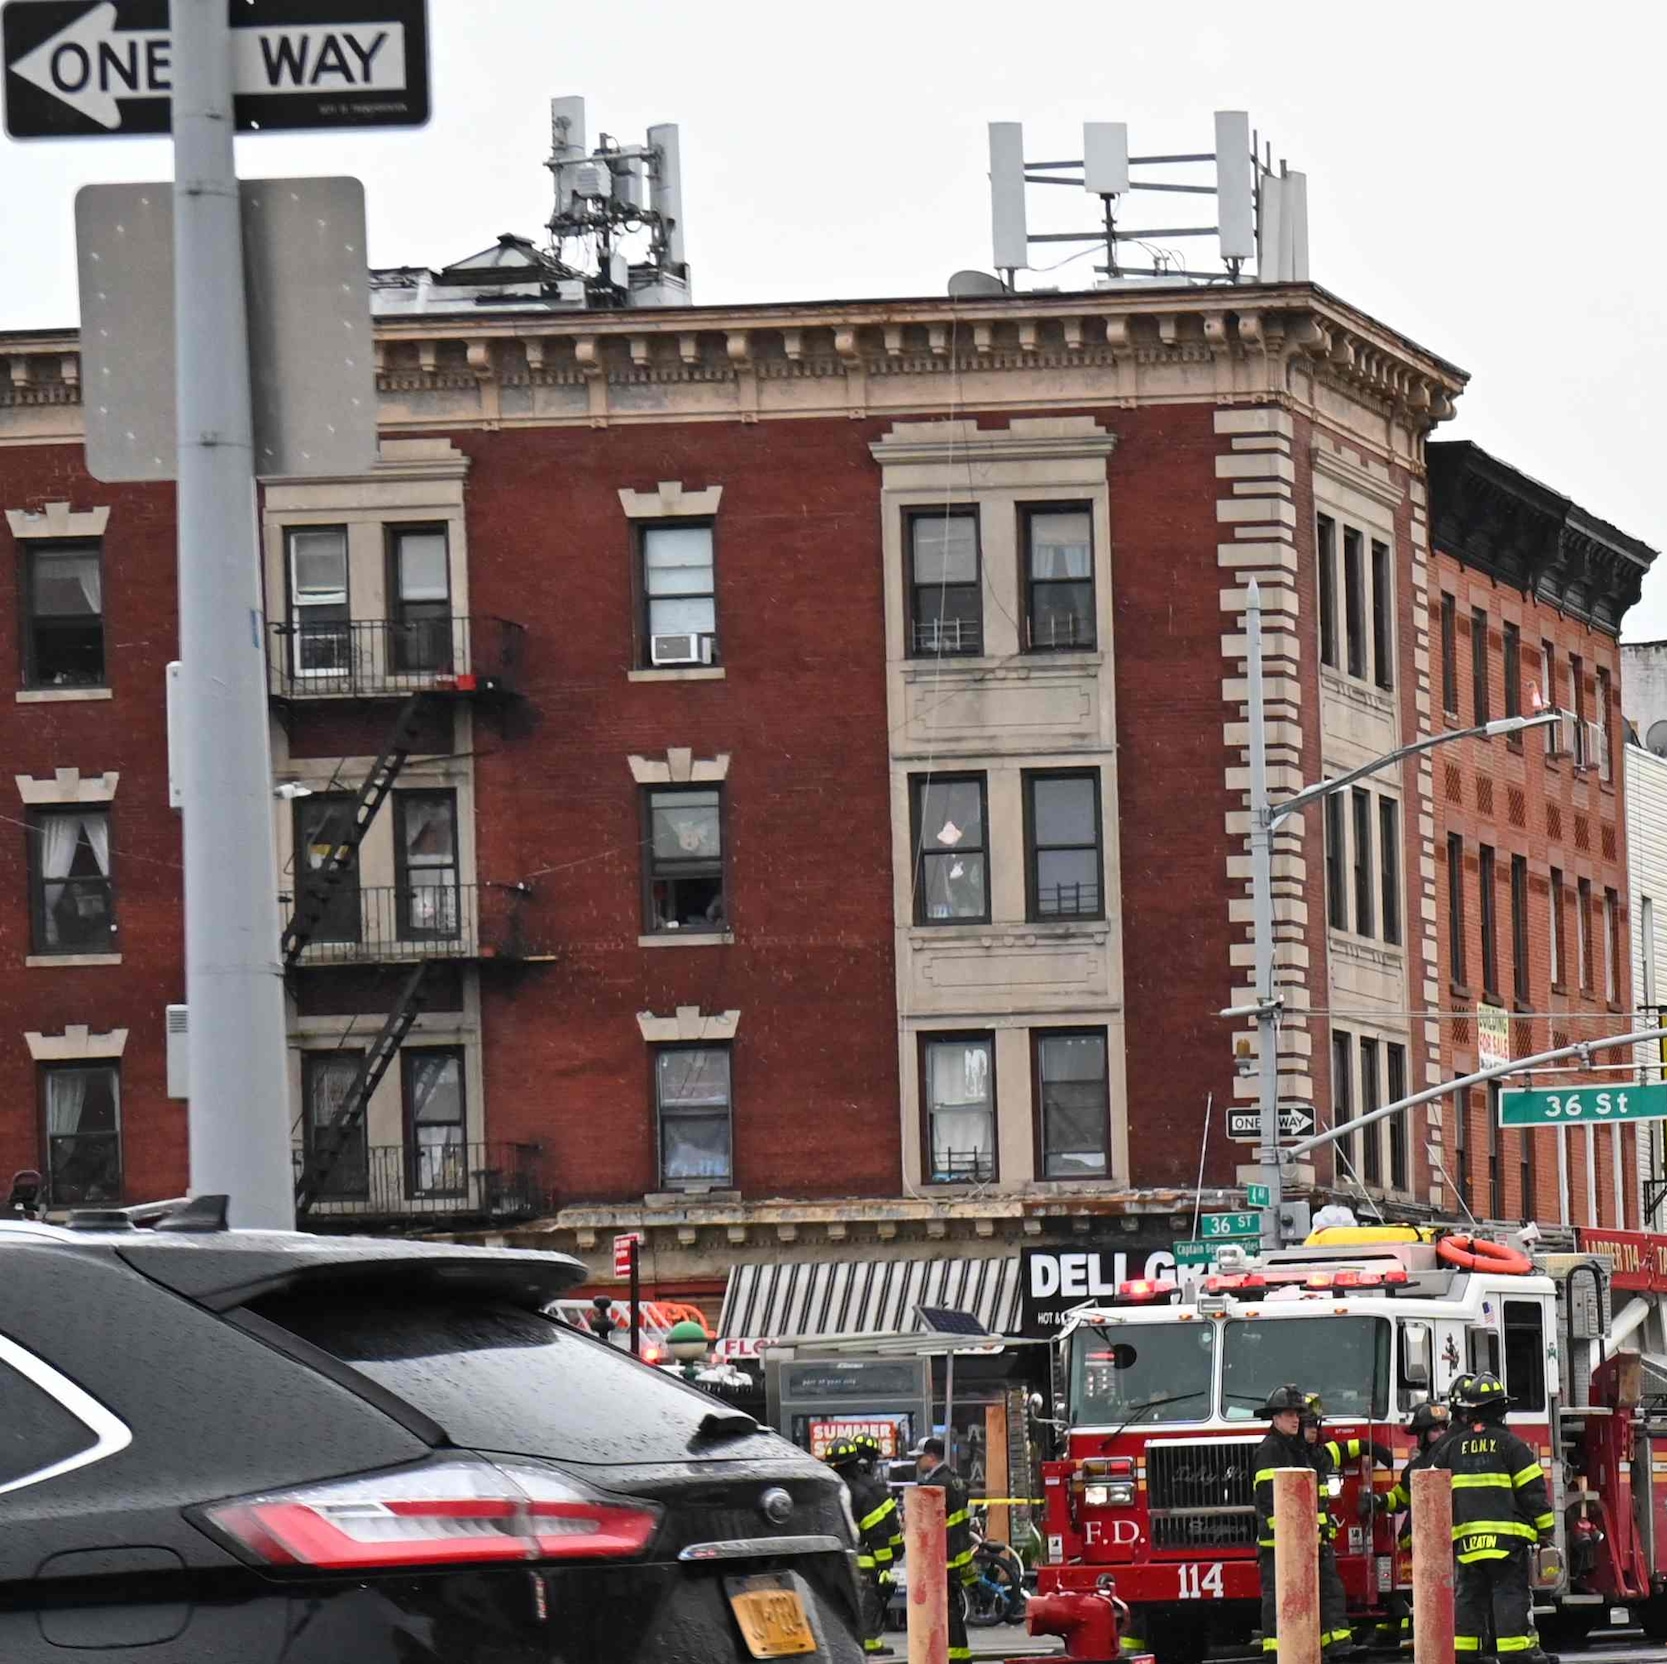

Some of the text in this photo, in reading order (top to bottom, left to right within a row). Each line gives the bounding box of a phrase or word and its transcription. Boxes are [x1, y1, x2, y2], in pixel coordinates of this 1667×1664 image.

[50, 32, 389, 93] ONE WAY
[1544, 1092, 1628, 1117] 36 St
[1235, 1117, 1304, 1129] ONE WAY
[1211, 1215, 1252, 1234] 36 ST
[1177, 1243, 1205, 1257] Captain
[1623, 1244, 1640, 1273] 114
[1030, 1252, 1128, 1298] DELI
[1038, 1312, 1054, 1325] HOT
[813, 1423, 891, 1440] SUMMER
[1085, 1520, 1146, 1545] F.D.
[1178, 1562, 1225, 1599] 114
